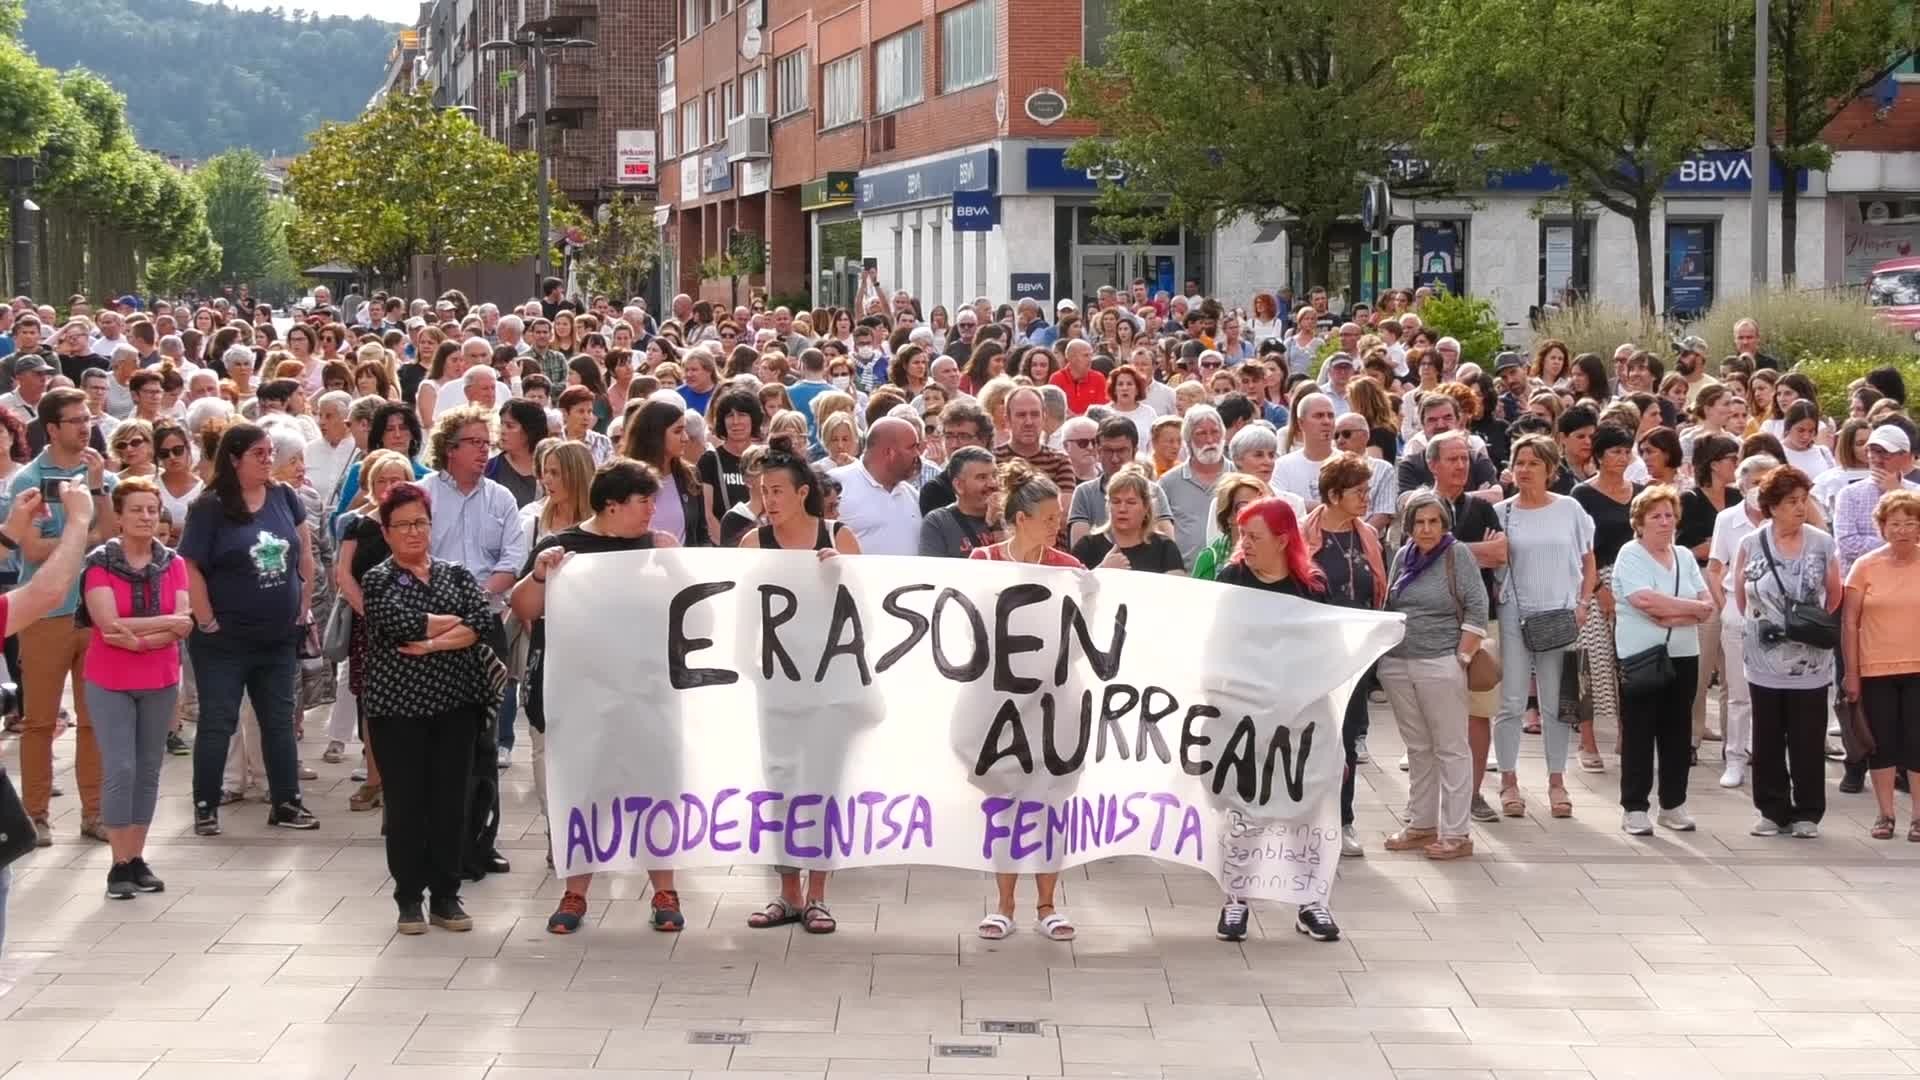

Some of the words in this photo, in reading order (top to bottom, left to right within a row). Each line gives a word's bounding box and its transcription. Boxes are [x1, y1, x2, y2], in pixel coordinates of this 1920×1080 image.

[1680, 157, 1753, 182] BBVA
[956, 205, 990, 217] BBVA
[1016, 282, 1045, 293] BBVA
[668, 581, 1128, 694] ERASOEN
[975, 684, 1316, 806] AURREAN
[567, 788, 934, 869] AUTODEFENTSA
[980, 792, 1204, 861] FEMINISTA
